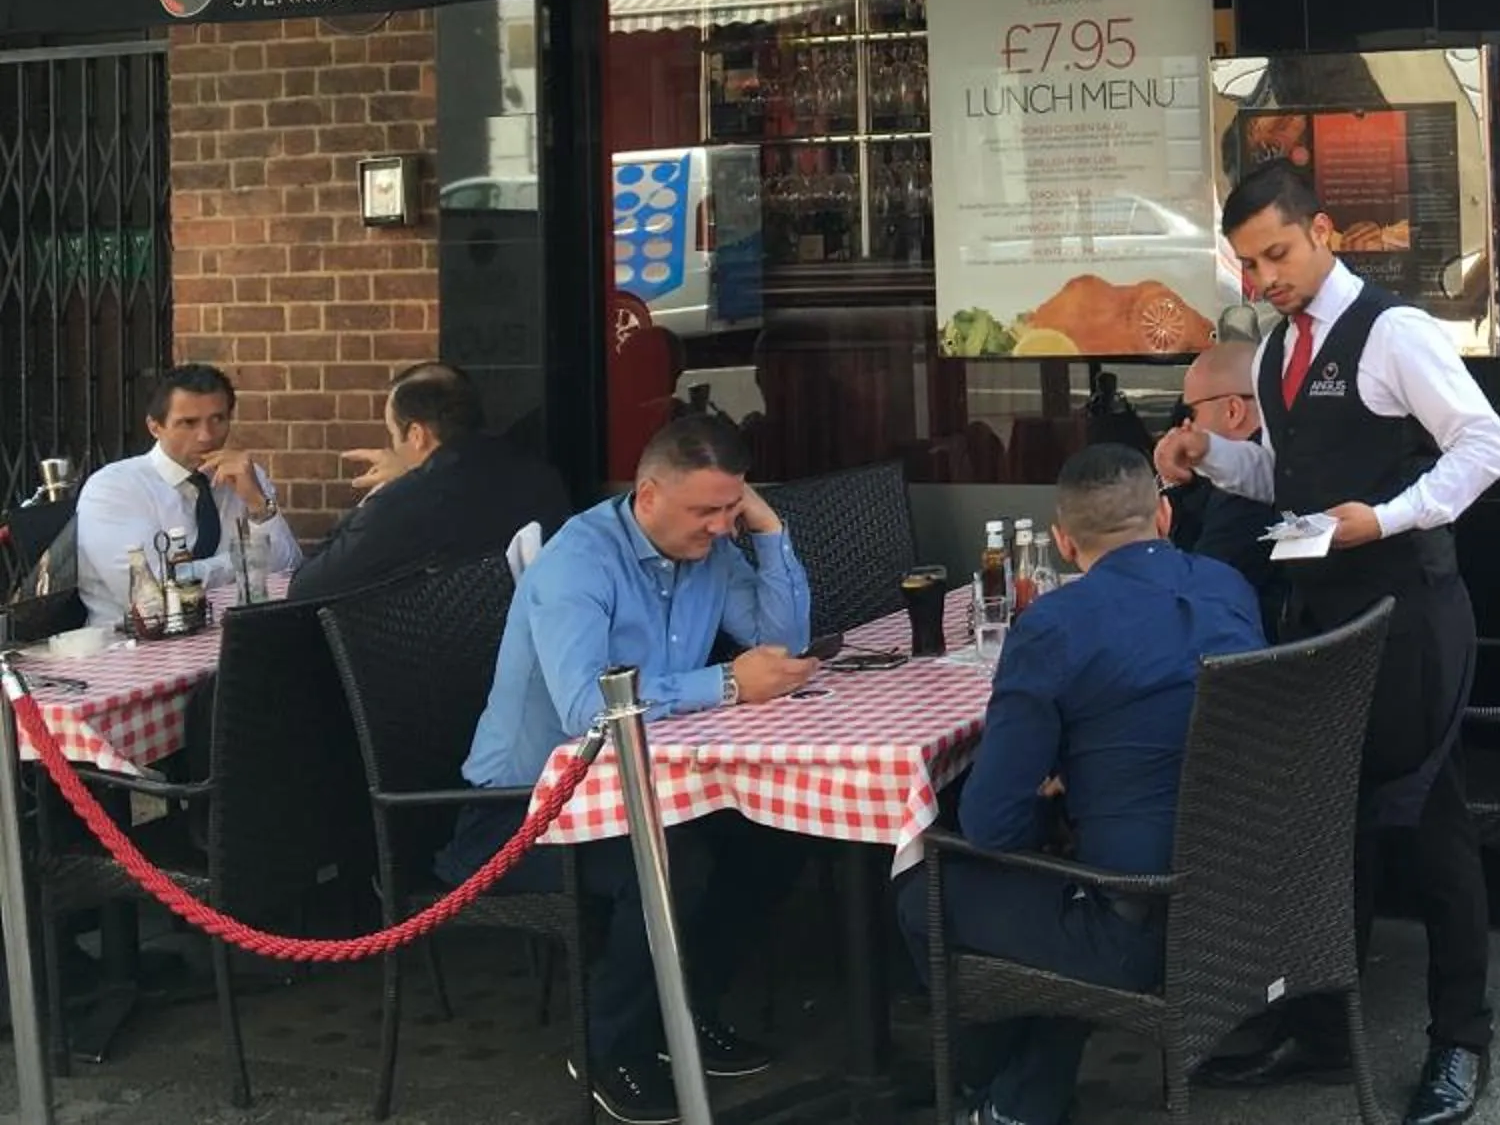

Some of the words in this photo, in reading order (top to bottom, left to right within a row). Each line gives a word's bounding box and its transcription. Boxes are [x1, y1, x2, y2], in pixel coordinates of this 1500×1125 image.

[1001, 17, 1136, 74] £7.95
[965, 81, 1074, 118] LUNCH
[1081, 78, 1176, 113] MENU
